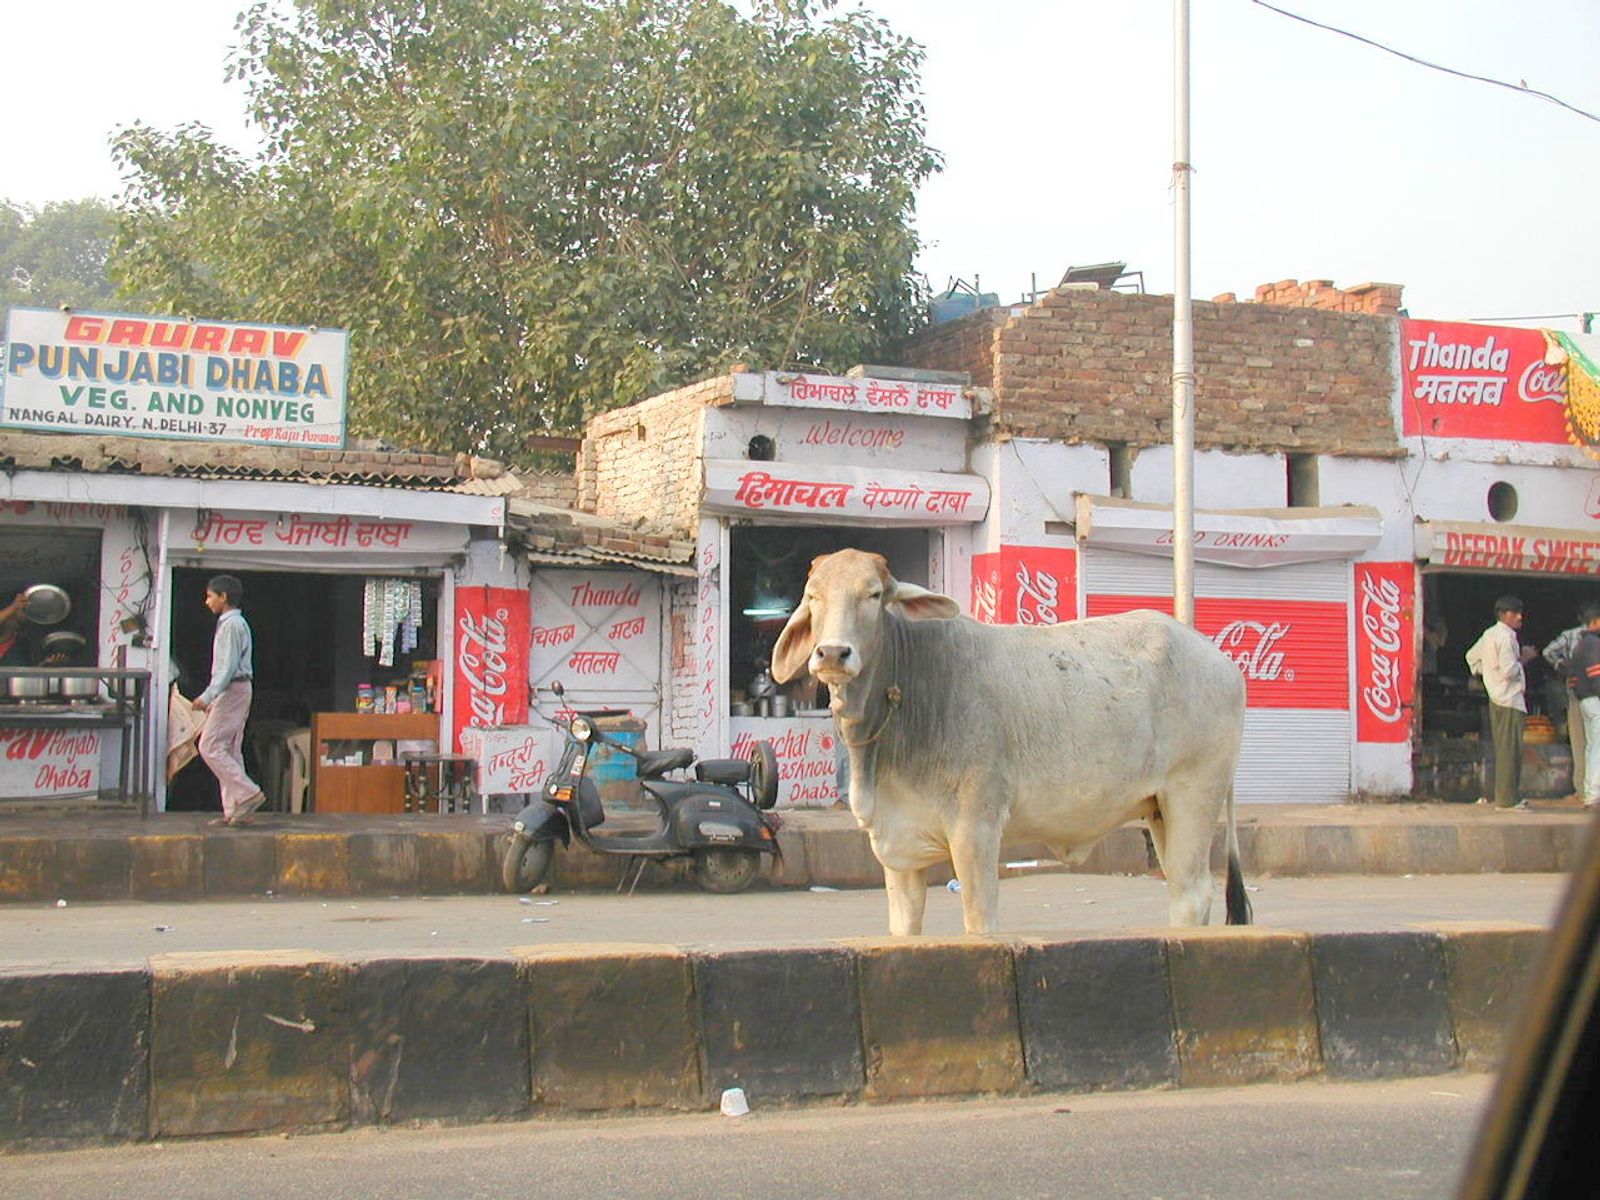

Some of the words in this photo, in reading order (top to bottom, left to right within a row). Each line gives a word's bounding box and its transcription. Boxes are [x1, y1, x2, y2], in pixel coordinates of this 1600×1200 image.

[64, 316, 311, 358] GAURAV
[1408, 332, 1509, 373] Thanda
[9, 342, 194, 389] PUNJABI
[206, 355, 333, 398] DHABA
[60, 386, 137, 411] VEG.
[148, 392, 204, 415] AND
[216, 397, 314, 423] NONVEG
[1413, 375, 1509, 406] मतलब
[10, 408, 78, 425] NANGAL
[735, 472, 853, 508] हिमाचल
[1213, 533, 1290, 548] DRINKS
[1444, 532, 1526, 570] DEEPAK
[572, 581, 641, 608] Thanda
[530, 624, 575, 648] चिकन
[608, 617, 645, 641] मटन
[569, 652, 621, 674] मतलब
[35, 764, 92, 791] Dhaba
[790, 781, 840, 801] Dhaba
